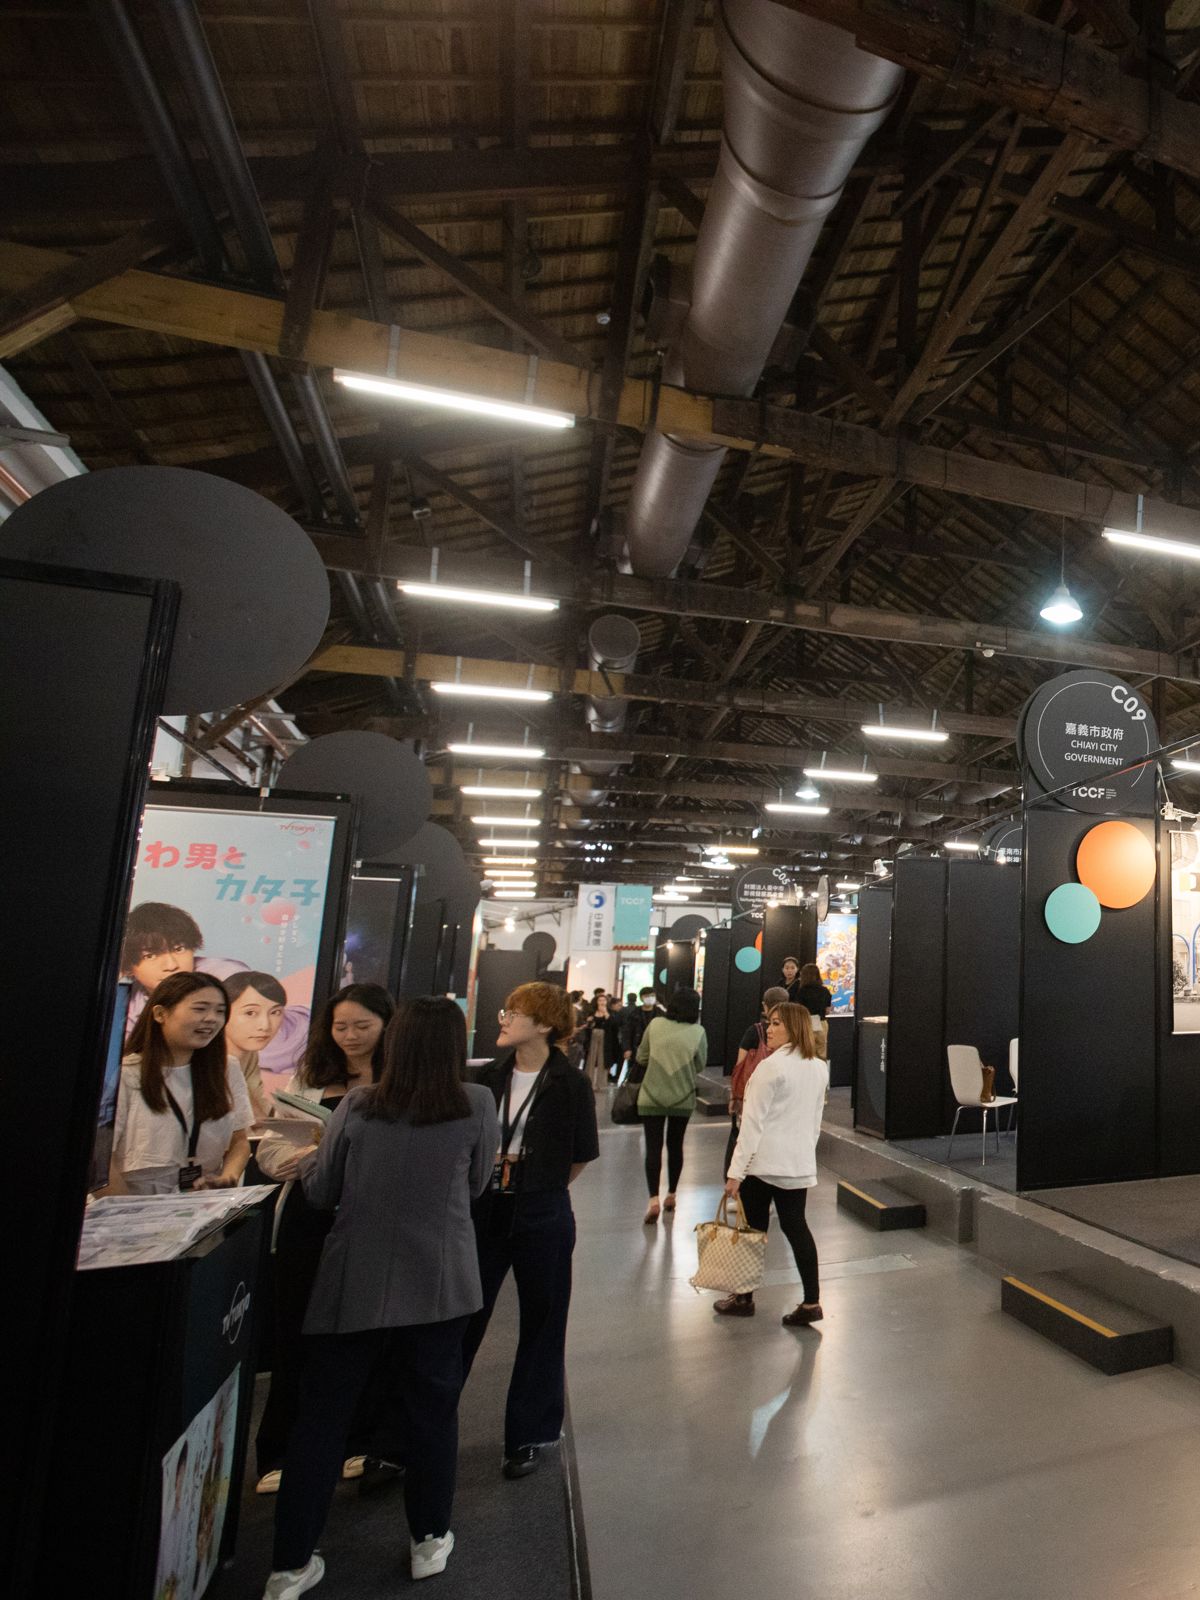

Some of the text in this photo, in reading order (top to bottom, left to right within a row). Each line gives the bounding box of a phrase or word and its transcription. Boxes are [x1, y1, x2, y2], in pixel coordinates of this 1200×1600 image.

[1111, 685, 1147, 720] C09
[1065, 722, 1124, 740] 嘉義市政府
[1071, 740, 1118, 752] CHIAYI CITY
[1064, 752, 1123, 765] GOVERNMENT
